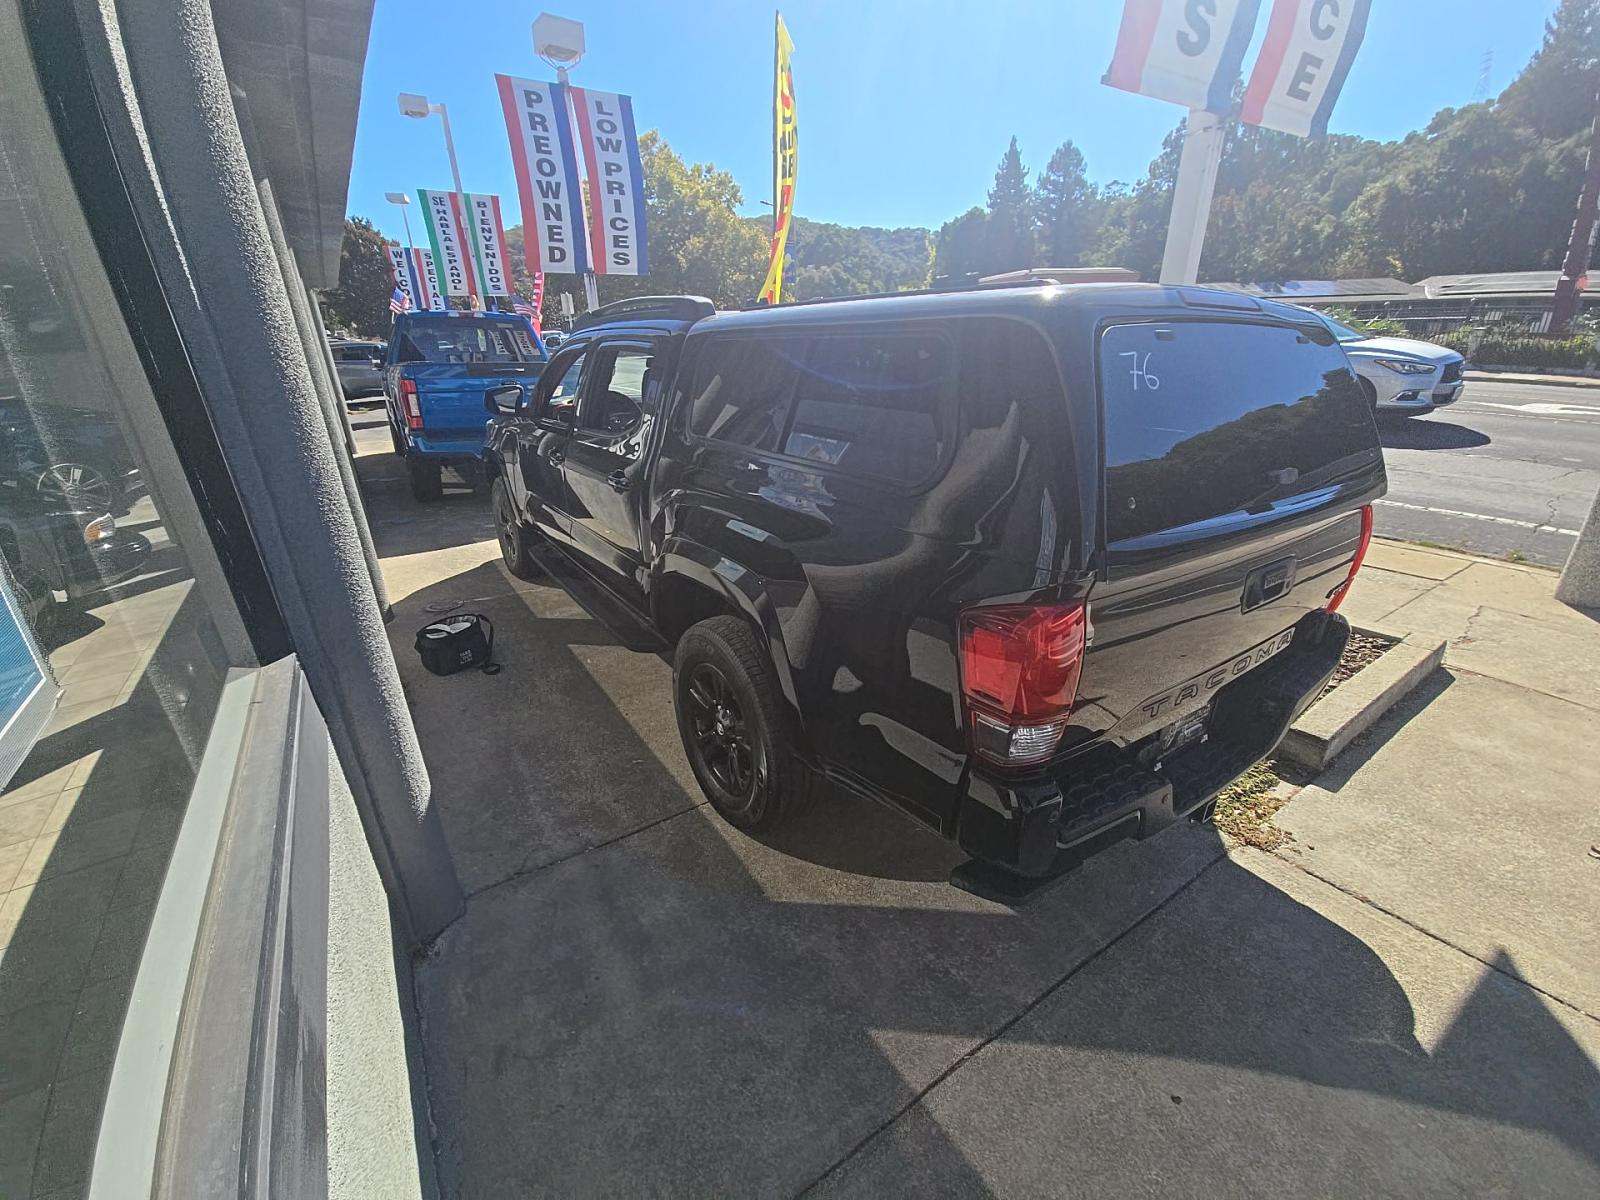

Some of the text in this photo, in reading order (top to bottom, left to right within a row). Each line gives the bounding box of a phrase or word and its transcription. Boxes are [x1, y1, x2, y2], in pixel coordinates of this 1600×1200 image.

[431, 196, 445, 207] SE
[523, 89, 567, 263] PREOWNED
[595, 100, 631, 266] LOW PRICES
[436, 208, 453, 242] HABLA
[476, 201, 501, 291] BIENVENIDOS
[1119, 351, 1160, 391] 76
[1141, 628, 1295, 718] TACOMA
